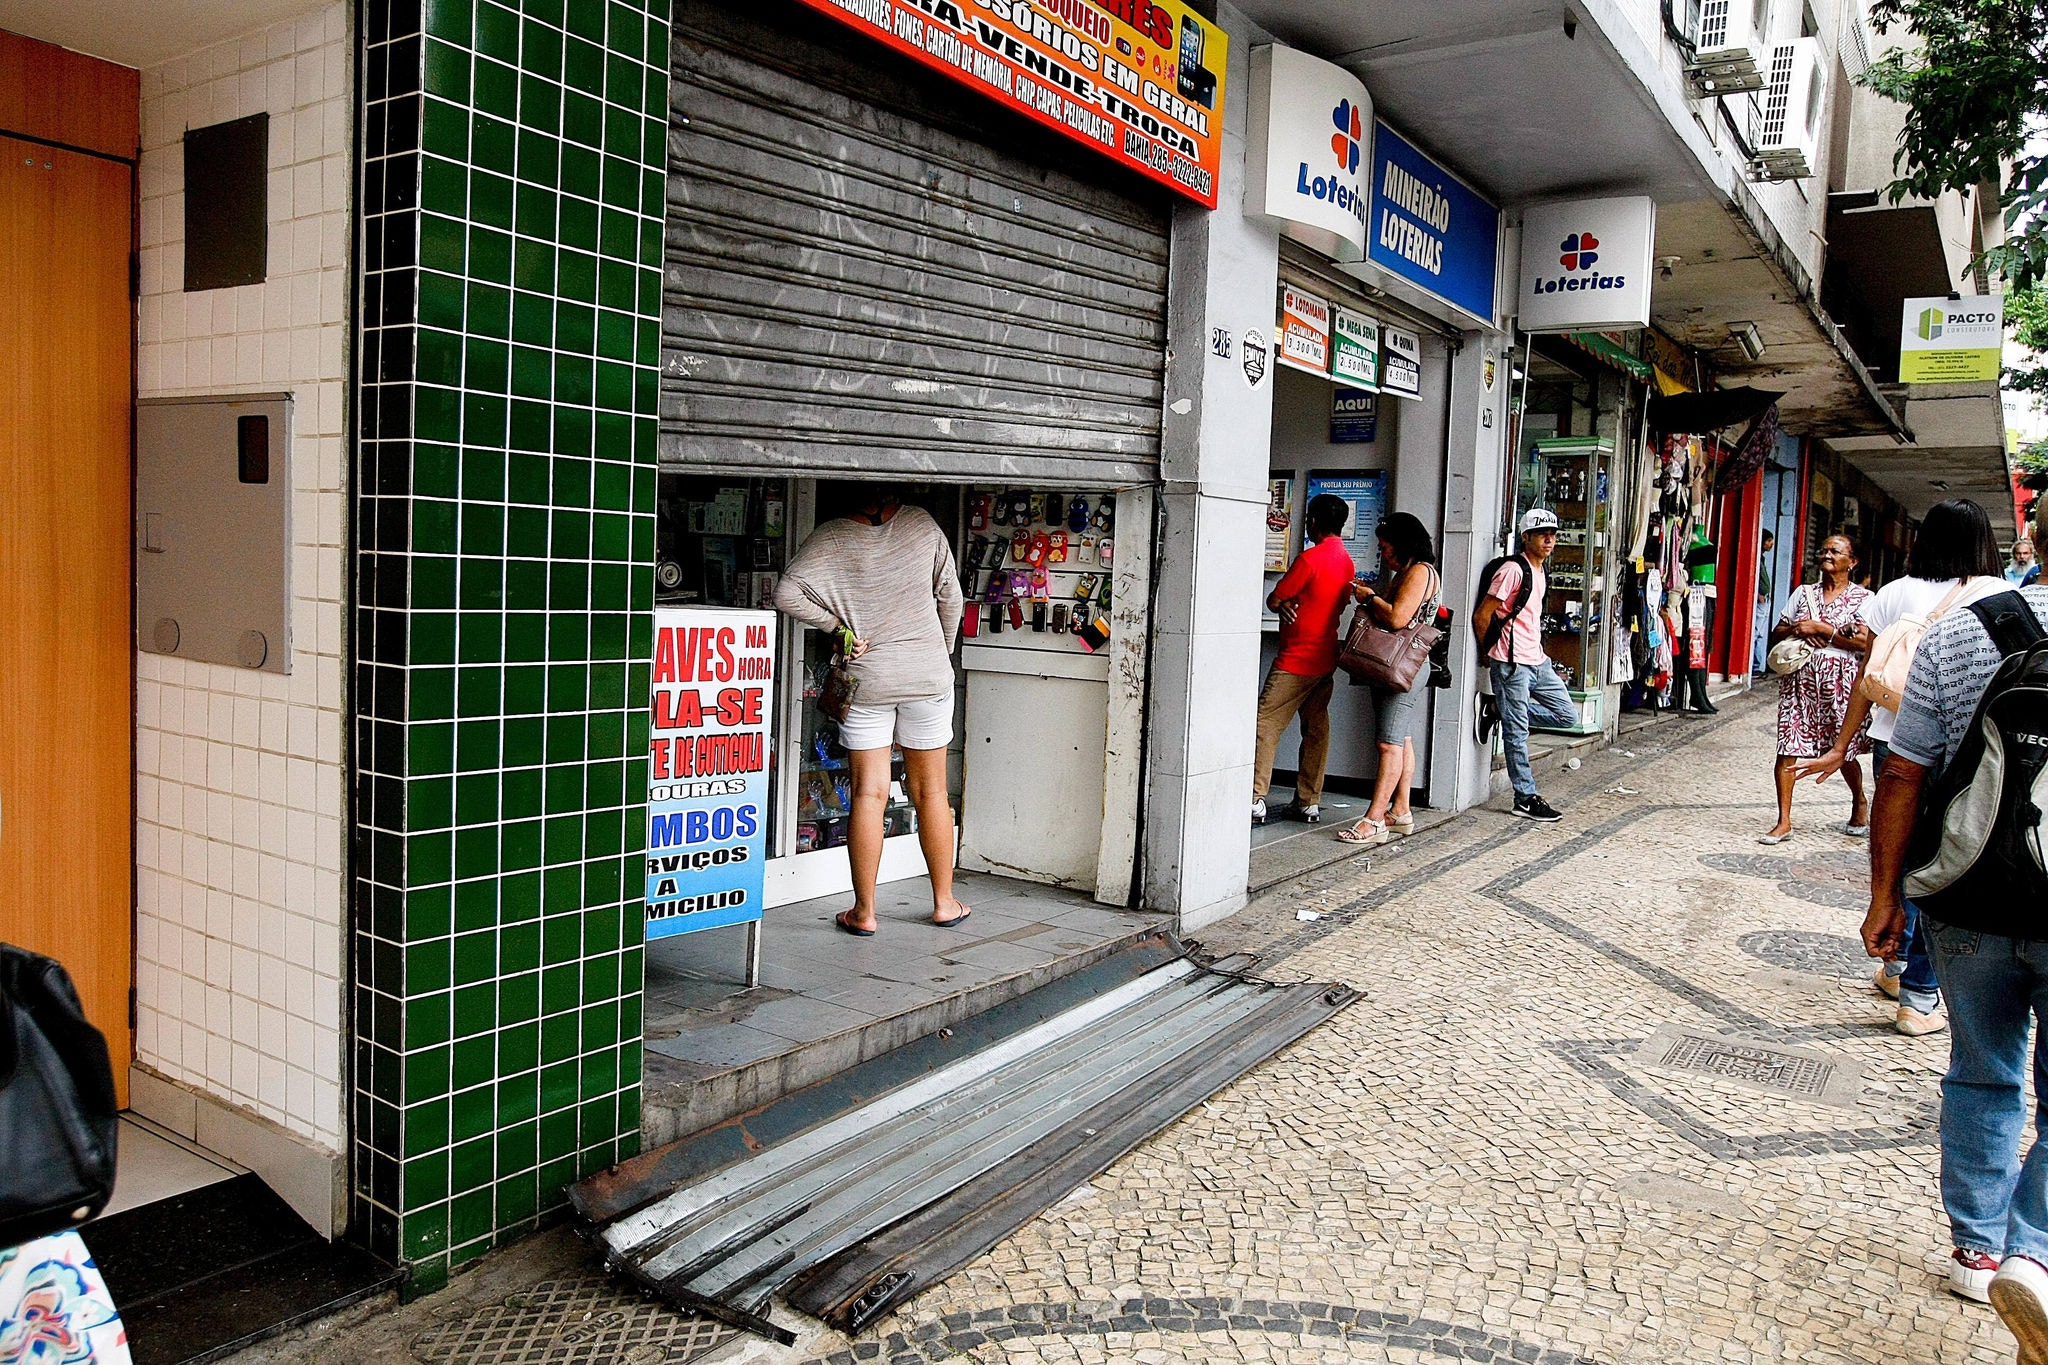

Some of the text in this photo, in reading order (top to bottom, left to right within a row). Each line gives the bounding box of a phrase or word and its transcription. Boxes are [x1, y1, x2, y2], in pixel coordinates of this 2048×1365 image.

[1040, 0, 1111, 46] OQUEIO
[1092, 0, 1174, 50] RES
[894, 7, 925, 51] FONES,
[926, 25, 961, 67] CARTÃO
[961, 43, 973, 73] DE
[973, 54, 1013, 97] MEMÓRIA,
[1016, 74, 1036, 109] CHIP,
[1036, 85, 1062, 123] CAPAS,
[1063, 98, 1101, 140] PELICULAS
[1101, 119, 1115, 148] ETC.
[1124, 129, 1151, 168] BAHIA,
[1102, 54, 1139, 97] EM
[1143, 80, 1209, 138] GERAL
[1382, 160, 1450, 234] MINEIRÃO
[1379, 207, 1443, 277] LOTERIAS
[1534, 271, 1625, 295] Loterias
[1295, 296, 1327, 322] LOTOMANIA
[1948, 313, 1996, 324] PACTO
[1213, 329, 1231, 358] 285
[1288, 322, 1323, 344] ACUMULADA
[1346, 319, 1376, 341] MEGA SENA
[1340, 342, 1373, 361] ACUMULADA
[1399, 336, 1414, 352] QUINA
[1388, 356, 1417, 372] ACUMULADA
[1335, 398, 1371, 411] AQUI
[653, 625, 767, 683] AVES NA
[738, 656, 771, 680] HORA
[651, 687, 763, 729] LA-SE
[674, 736, 694, 779] DE
[695, 732, 763, 778] CUTICULA
[649, 779, 747, 802] OURAS
[651, 804, 757, 849] MBOS
[656, 878, 677, 897] A
[646, 890, 745, 920] MICILIO
